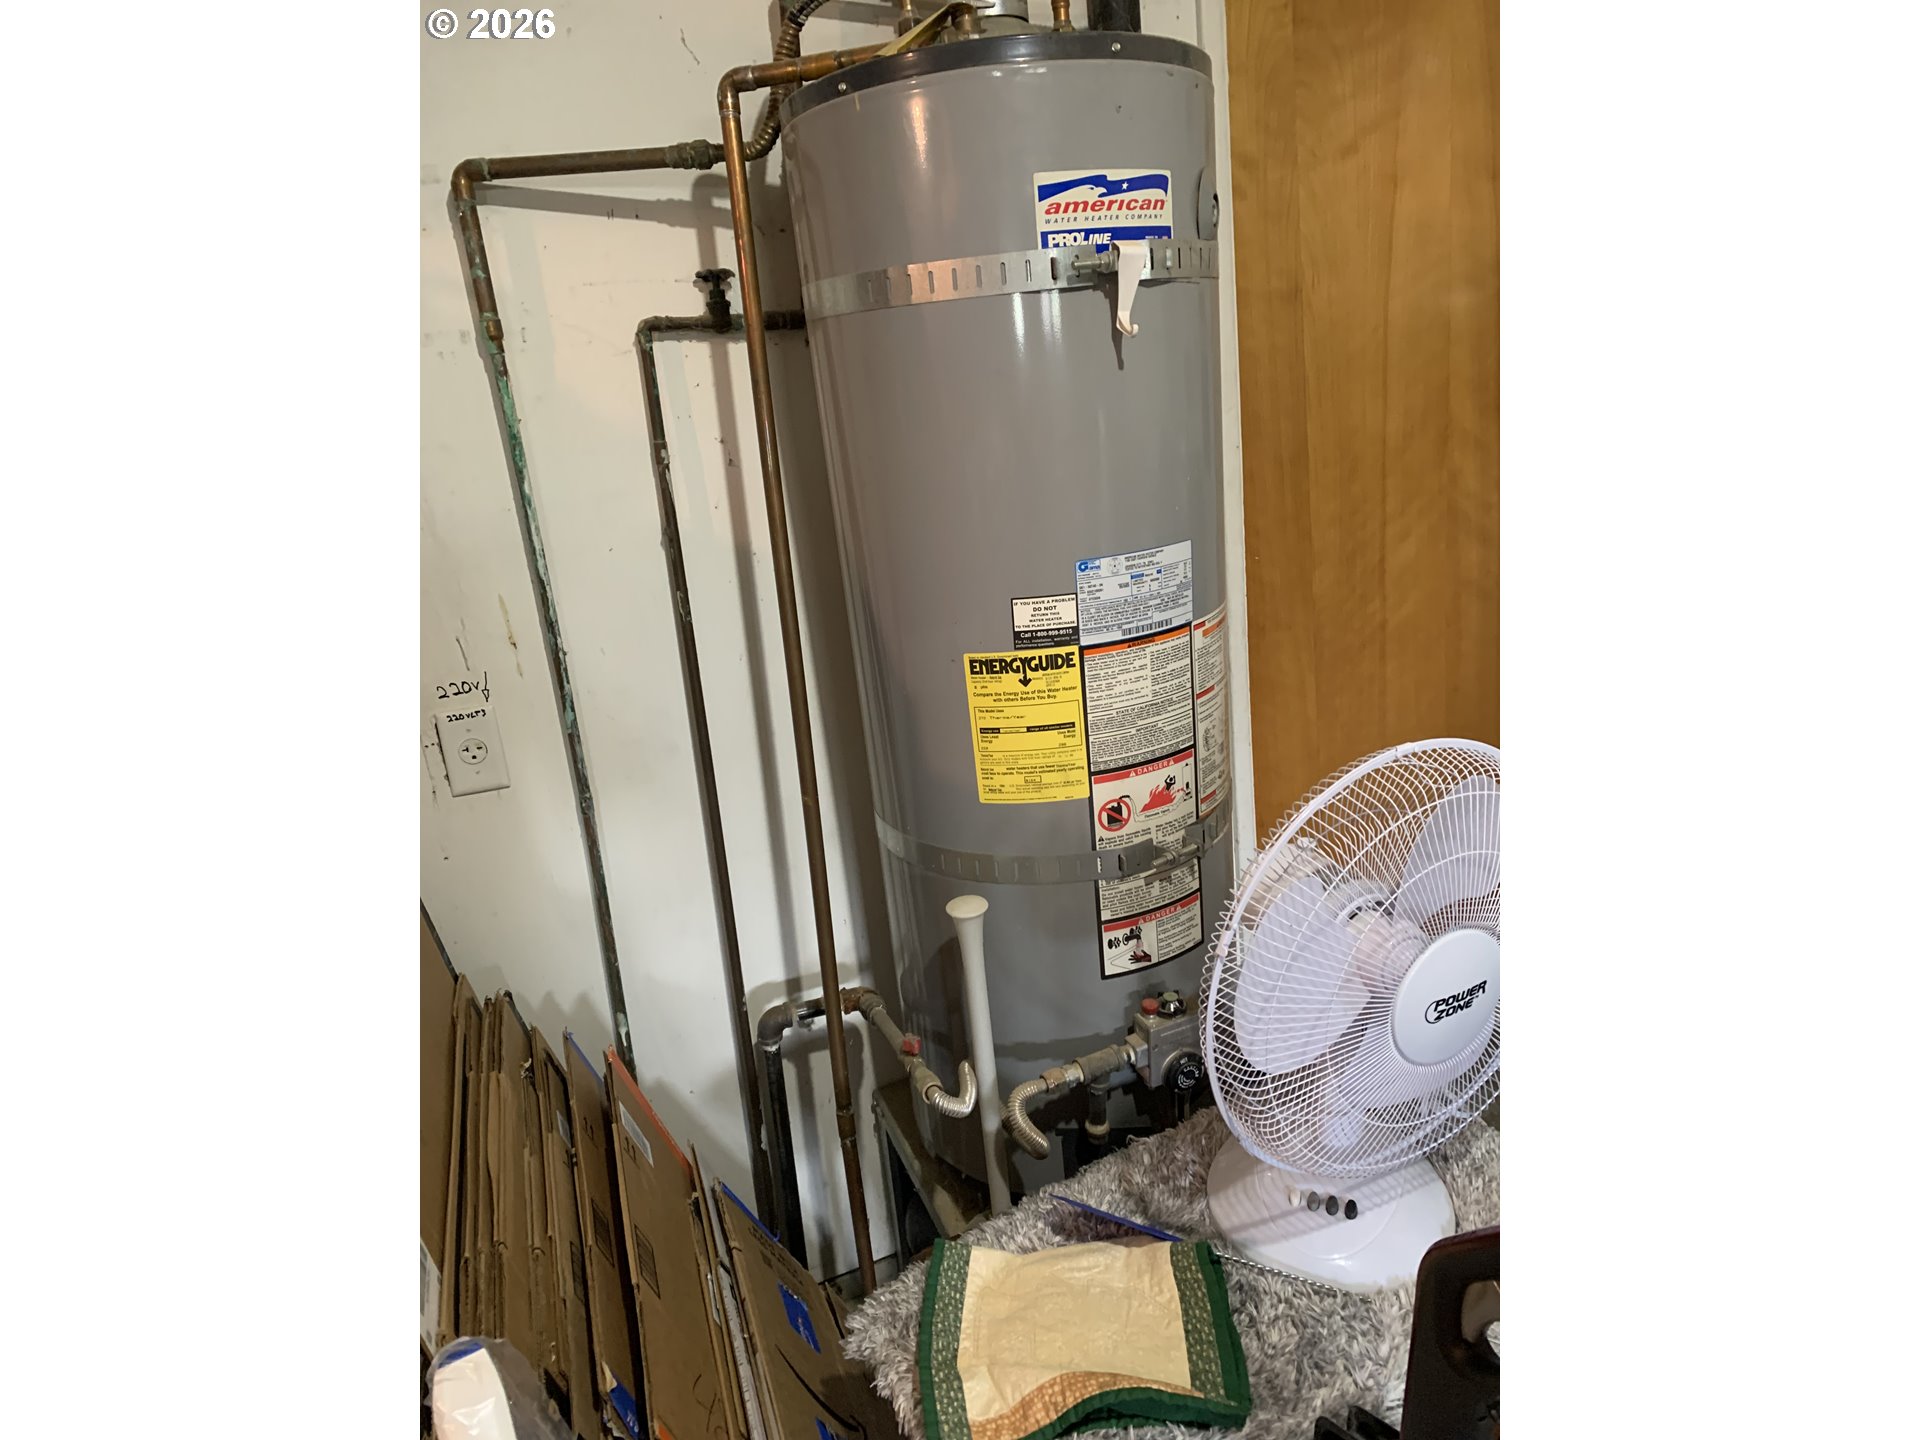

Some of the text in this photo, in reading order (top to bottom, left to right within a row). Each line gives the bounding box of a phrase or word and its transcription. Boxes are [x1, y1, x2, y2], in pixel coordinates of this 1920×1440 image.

[1045, 199, 1165, 215] american
[1045, 216, 1078, 225] WATER
[1084, 214, 1120, 222] HEATER
[969, 652, 1076, 675] ENERGYGUIDE
[436, 681, 480, 699] 220V
[1137, 702, 1160, 711] CALIFORNIA
[1136, 723, 1159, 732] IMPORTANT
[1137, 760, 1171, 775] DANGER
[1146, 906, 1177, 922] DANGER
[1434, 980, 1487, 1012] POWER
[1434, 997, 1475, 1021] ZONE
